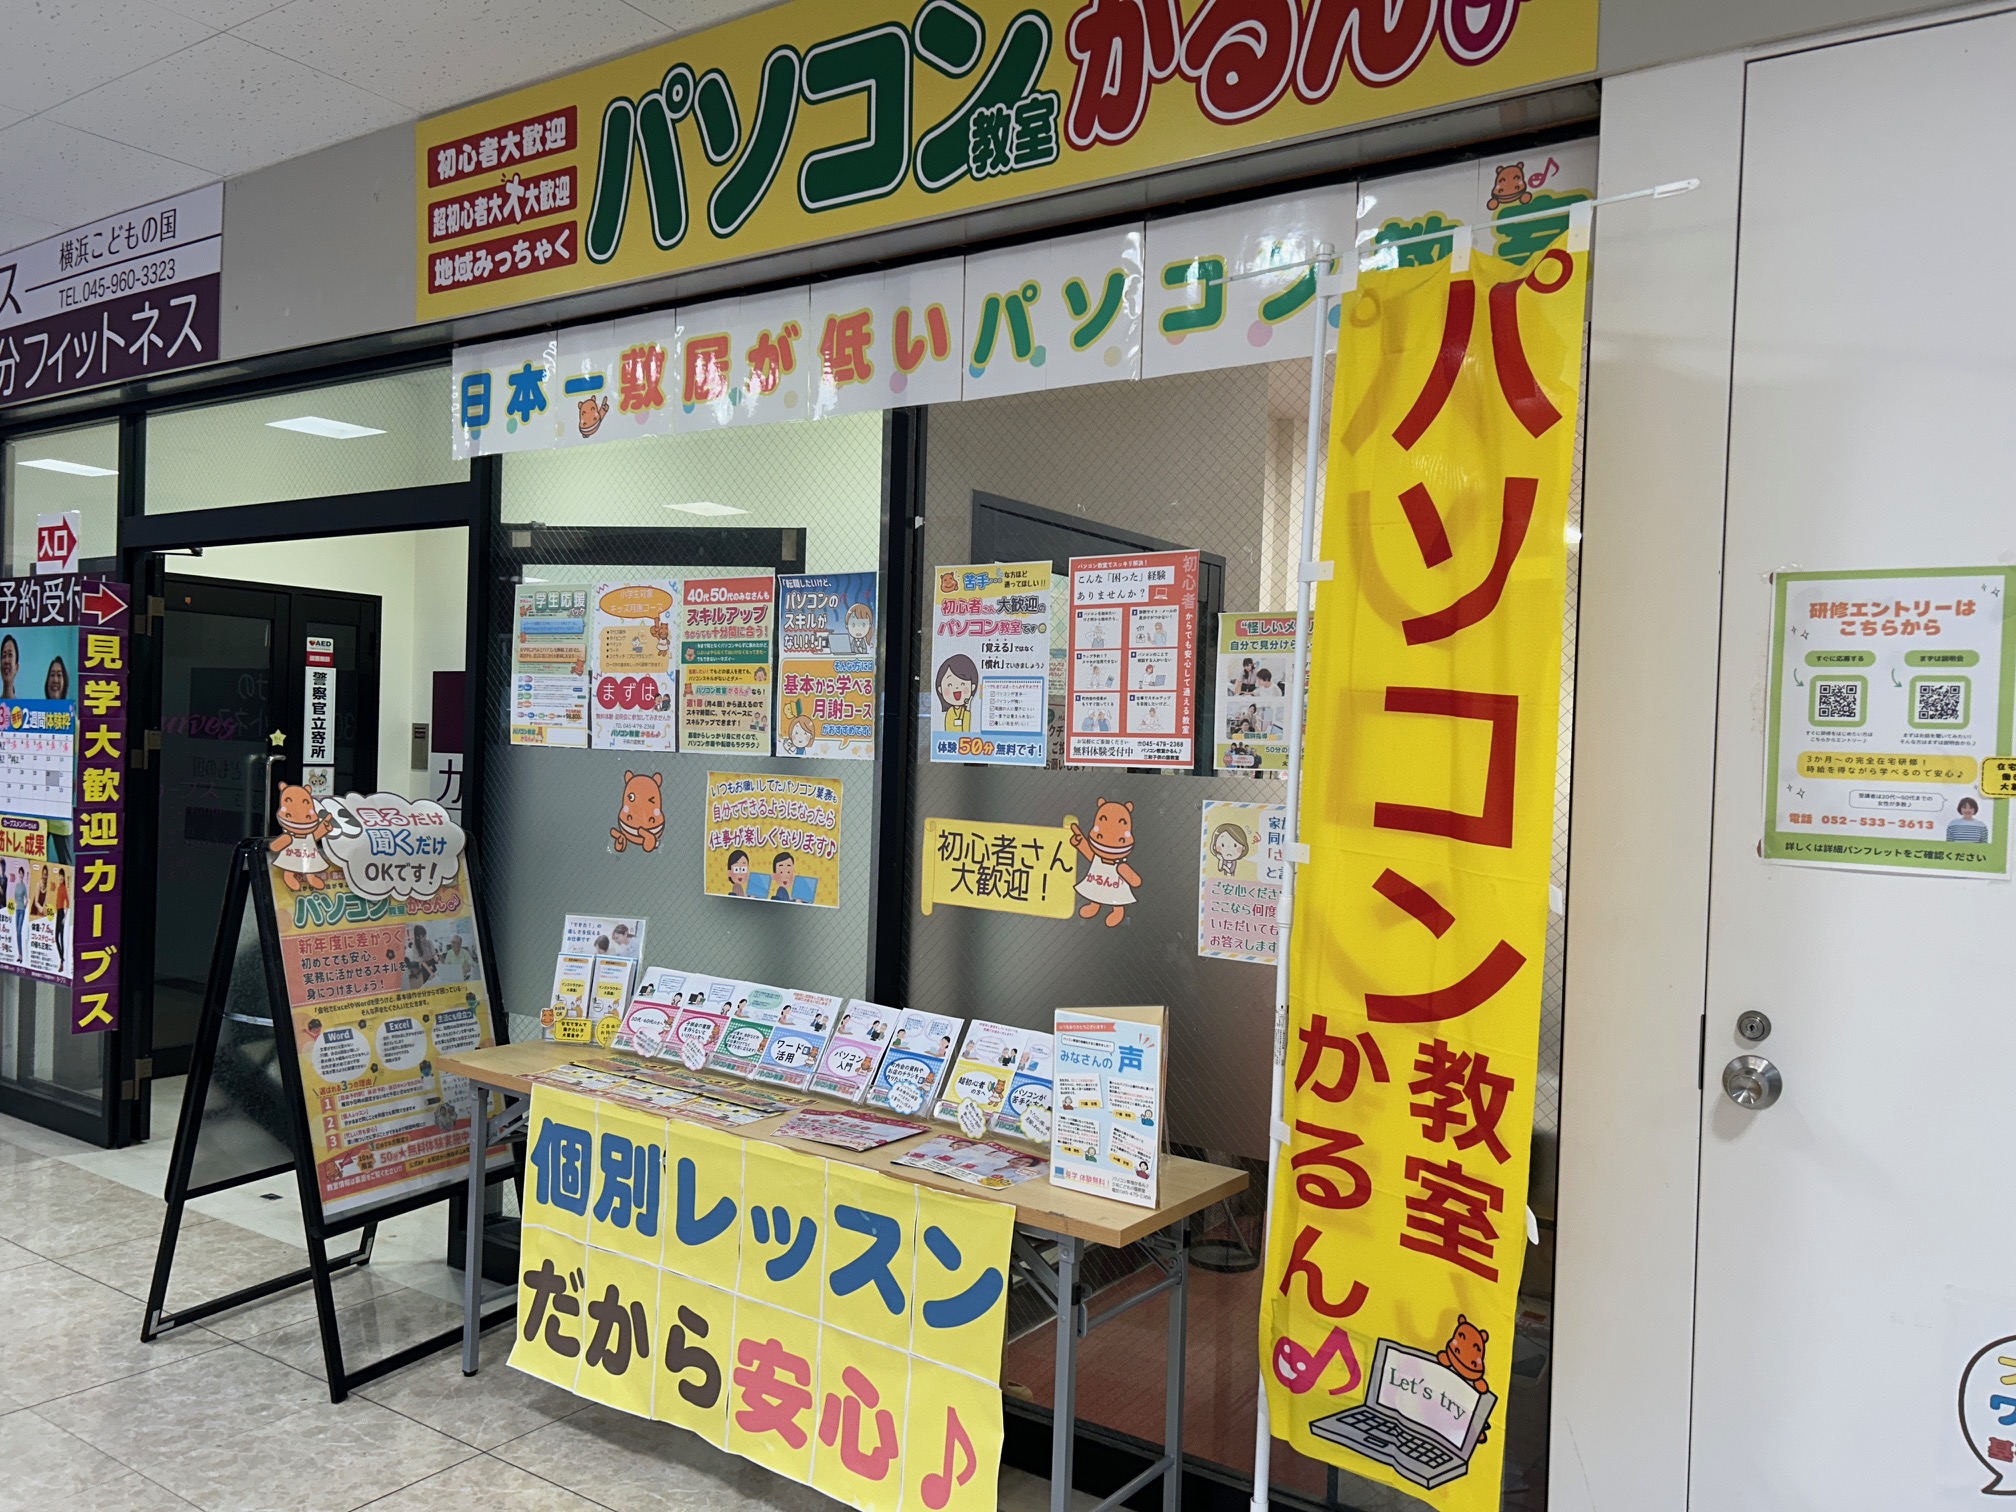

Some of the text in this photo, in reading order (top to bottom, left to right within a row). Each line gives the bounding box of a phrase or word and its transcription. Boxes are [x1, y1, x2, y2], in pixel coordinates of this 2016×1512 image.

[970, 92, 1060, 178] 教室
[437, 115, 567, 179] 初心者大歓迎
[59, 208, 178, 272] 横浜こどもの国
[434, 229, 571, 288] 地域みっちゃく
[58, 258, 176, 308] TEL.045-960-3323
[39, 530, 68, 557] 入口
[1004, 570, 1028, 579] な方ほど
[1078, 570, 1166, 584] こんな「困った」経験
[535, 592, 586, 609] 学生応援
[785, 592, 838, 610] パソコンの
[1077, 589, 1145, 600] ありませんか？
[686, 605, 768, 626] スキルアップ
[1809, 600, 1976, 619] 研修エントリーは
[784, 613, 827, 629] スキルが
[1839, 618, 1941, 636] こちらから
[832, 660, 875, 673] そんな方には
[603, 683, 656, 702] まずは
[783, 673, 873, 696] 基本から学べる
[310, 671, 328, 759] 警察官立寄所
[812, 698, 873, 720] 月謝コース
[1073, 746, 1133, 757] 無料体験受付中
[711, 779, 838, 804] いつもお願いしてたパソコン業務も
[356, 807, 443, 828] 見るだけ
[713, 798, 836, 829] 自分でできるようになったら
[1789, 813, 1934, 830] 電話 052-533-3613
[77, 633, 124, 1028] 見学大歓迎カーブス
[365, 829, 447, 856] 聞くだけ
[937, 830, 1073, 872] 初心者さん
[1785, 842, 1987, 863] 詳しくは詳細パンフレットをご確認ください
[950, 863, 1048, 902] 大歓迎！
[1211, 919, 1279, 935] いただいても
[298, 928, 411, 955] 新年度に差がつく！
[1210, 935, 1277, 953] お答えします
[303, 961, 407, 985] 実務に活かせるスキルを
[306, 979, 385, 1000] 身につけましょう！
[327, 1031, 350, 1041] Word
[389, 1022, 411, 1031] Excel
[776, 1040, 802, 1053] ワード
[775, 1051, 795, 1064] 活用
[834, 1050, 863, 1064] パソコン
[1060, 1045, 1143, 1073] みなさんの 声
[837, 1063, 852, 1072] 入門
[319, 1078, 373, 1095] 選ばれる3つの理由
[958, 1076, 985, 1090] 超初心者
[324, 1099, 331, 1110] 1
[1015, 1089, 1047, 1101] パソコンが
[327, 1118, 335, 1129] 2
[330, 1136, 337, 1147] 3
[1278, 1013, 1391, 1318] かるん
[531, 1117, 1004, 1329] 個別レッスン
[1389, 1368, 1466, 1420] Let's try
